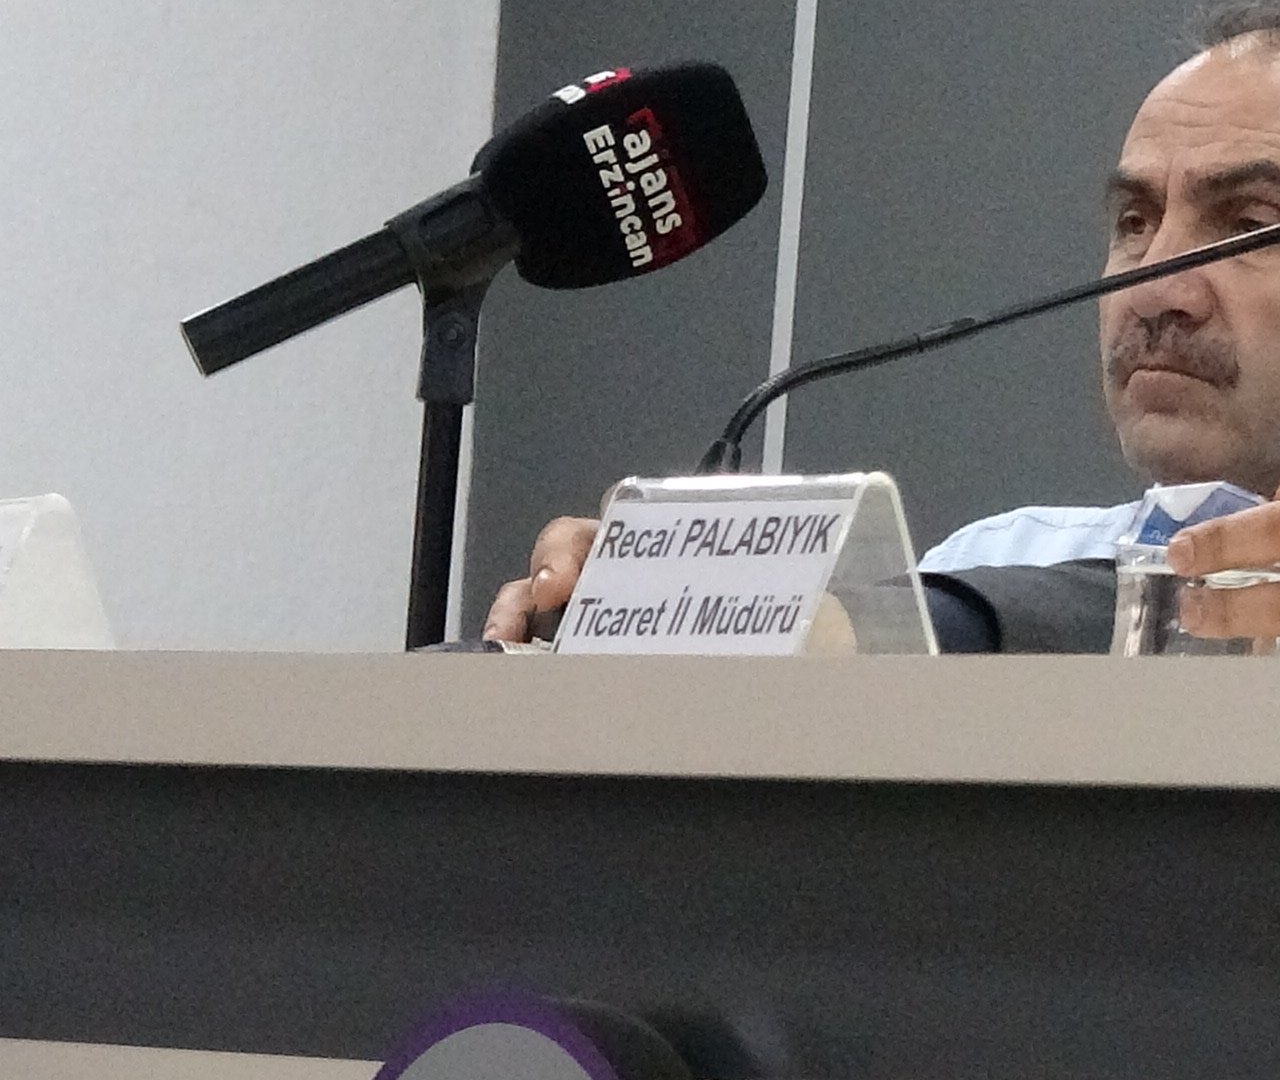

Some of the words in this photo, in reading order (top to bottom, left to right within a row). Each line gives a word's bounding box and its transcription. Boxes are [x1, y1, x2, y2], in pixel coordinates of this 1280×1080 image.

[583, 124, 654, 268] Erzincan
[623, 128, 683, 235] ajans
[597, 519, 682, 560] Recai
[679, 514, 842, 558] PALABIYIK
[573, 597, 668, 637] Ticaret
[695, 595, 803, 636] Müdürü
